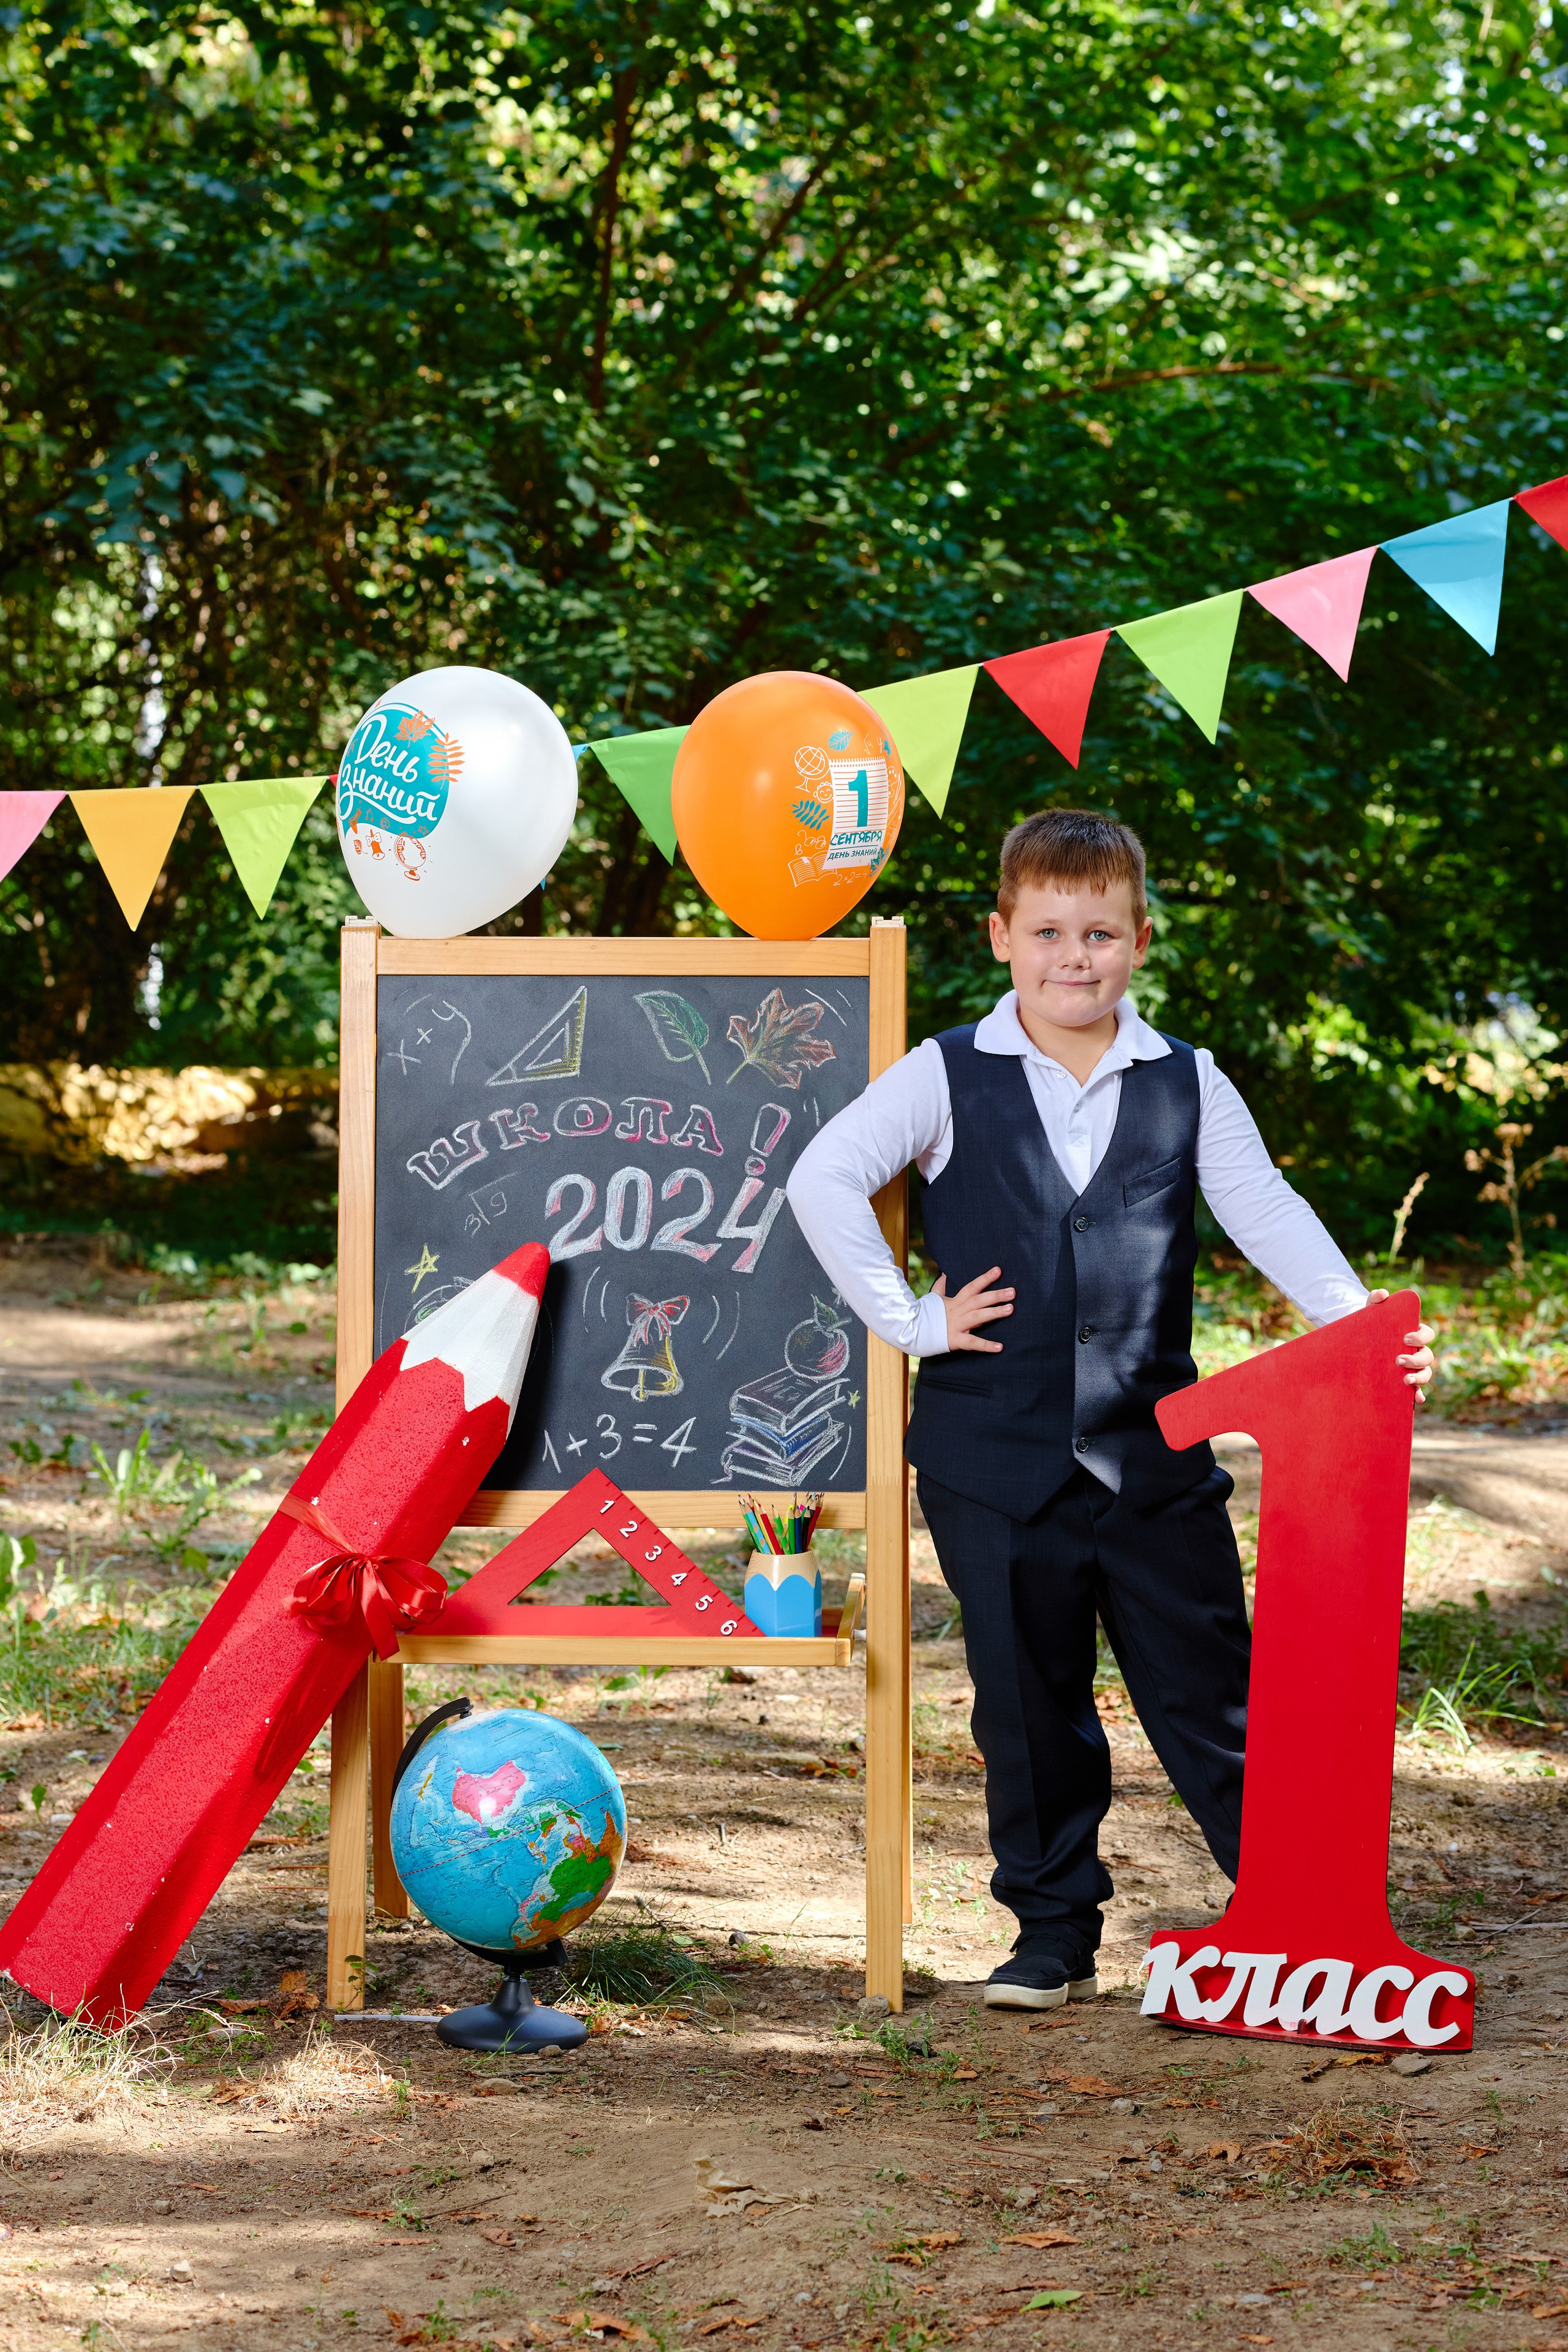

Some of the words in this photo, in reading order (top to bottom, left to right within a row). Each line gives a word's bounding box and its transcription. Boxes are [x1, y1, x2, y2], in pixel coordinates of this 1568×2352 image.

[353, 714, 420, 783] День
[848, 769, 869, 827] 1
[827, 850, 850, 861] ДЕНЬ
[851, 848, 878, 858] ЗНАНИЙ
[830, 830, 883, 846] СЕНТЯБРЯ
[406, 1096, 792, 1191] ШКОЛА!
[544, 1166, 787, 1274] 2024
[600, 1500, 615, 1513] 1
[619, 1520, 638, 1538] 2
[644, 1545, 662, 1561] 3
[670, 1572, 688, 1586] 4
[695, 1595, 714, 1611] 5
[720, 1619, 737, 1635] 6
